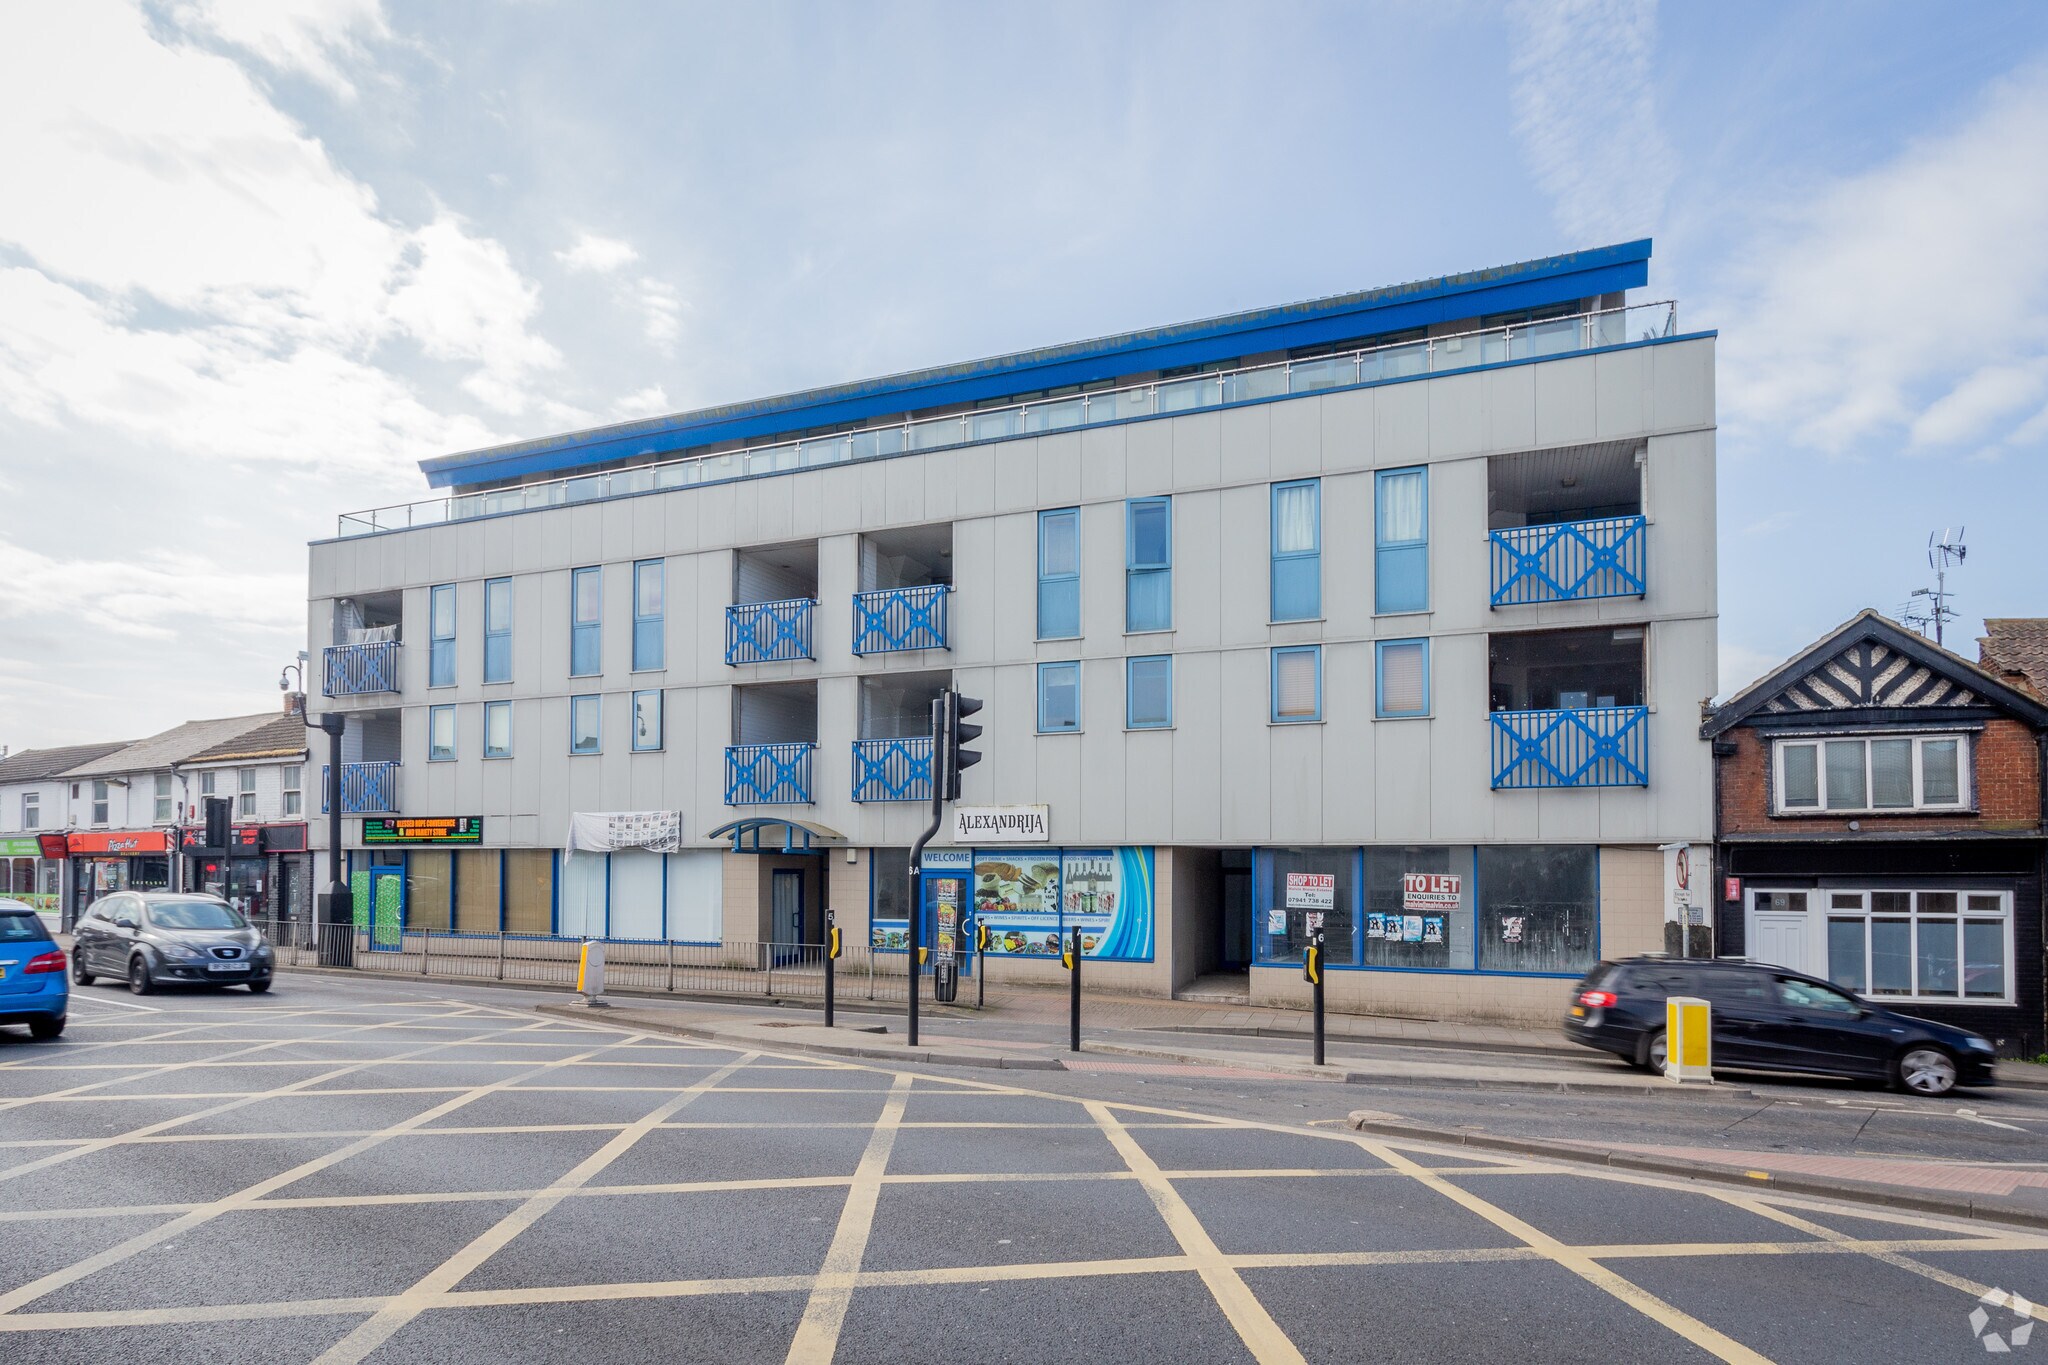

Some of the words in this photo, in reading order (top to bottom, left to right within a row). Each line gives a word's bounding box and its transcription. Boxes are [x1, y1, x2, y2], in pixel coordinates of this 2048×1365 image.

[107, 838, 124, 852] Pizza
[125, 836, 139, 848] Hut
[924, 853, 970, 862] WELCOME
[1289, 875, 1308, 886] SHOP
[1309, 876, 1319, 886] TO
[1319, 876, 1333, 887] LET
[1406, 875, 1427, 892] TO
[1431, 876, 1459, 893] LET
[827, 912, 834, 921] 5
[1318, 933, 1325, 942] 6
